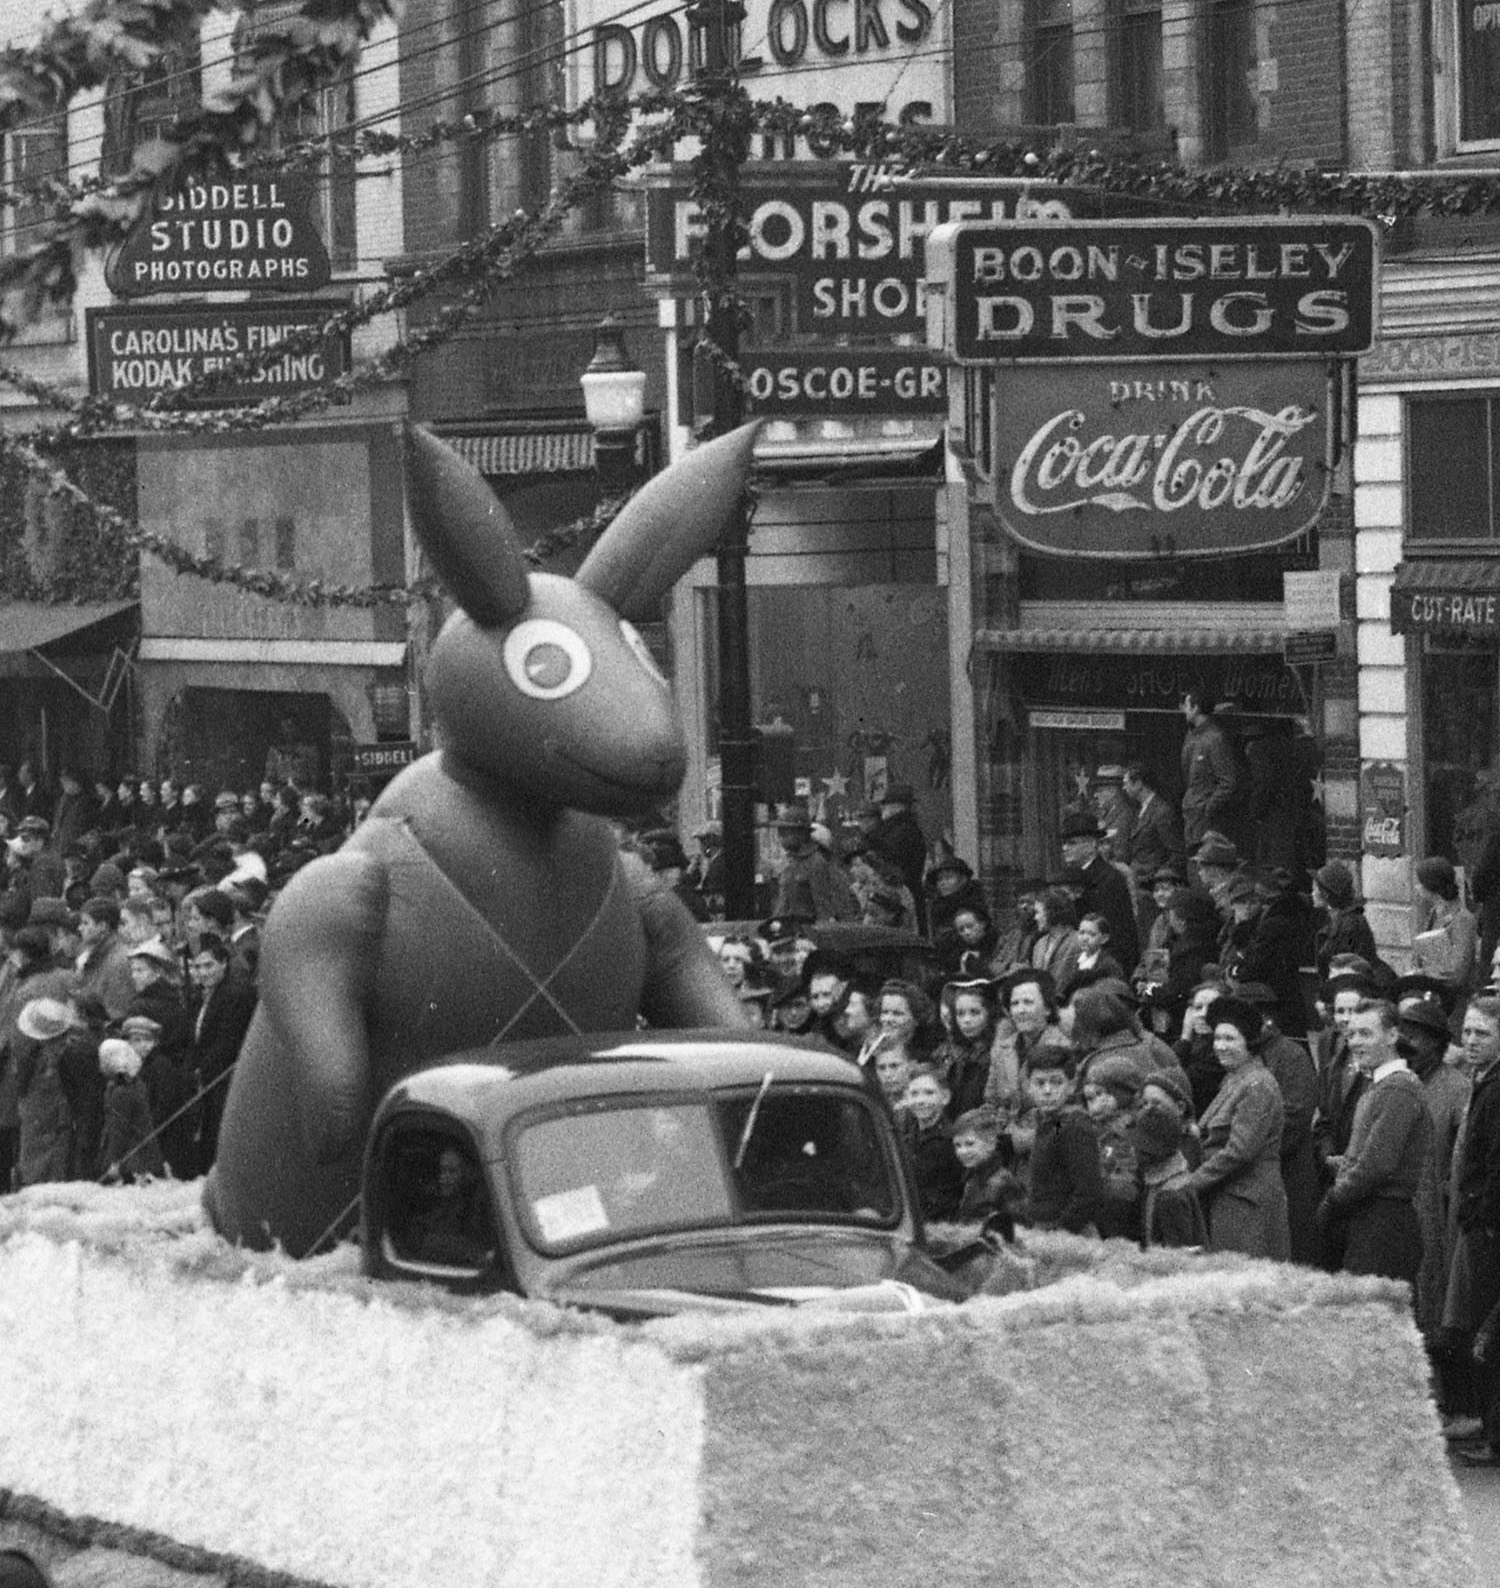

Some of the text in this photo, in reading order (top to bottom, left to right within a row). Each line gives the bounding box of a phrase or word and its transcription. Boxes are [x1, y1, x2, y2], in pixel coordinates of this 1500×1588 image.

[150, 217, 294, 252] STUDIO
[134, 257, 310, 282] PHOTOGRAPHS
[975, 289, 1351, 342] DRUGS
[110, 321, 239, 355] CAROLINA'S
[111, 357, 193, 390] KODAK
[748, 366, 943, 401] OSCOE-GR
[1109, 381, 1216, 402] DRINK
[1010, 405, 1317, 515] Coca-Cola
[1411, 592, 1496, 624] CUT-RATE
